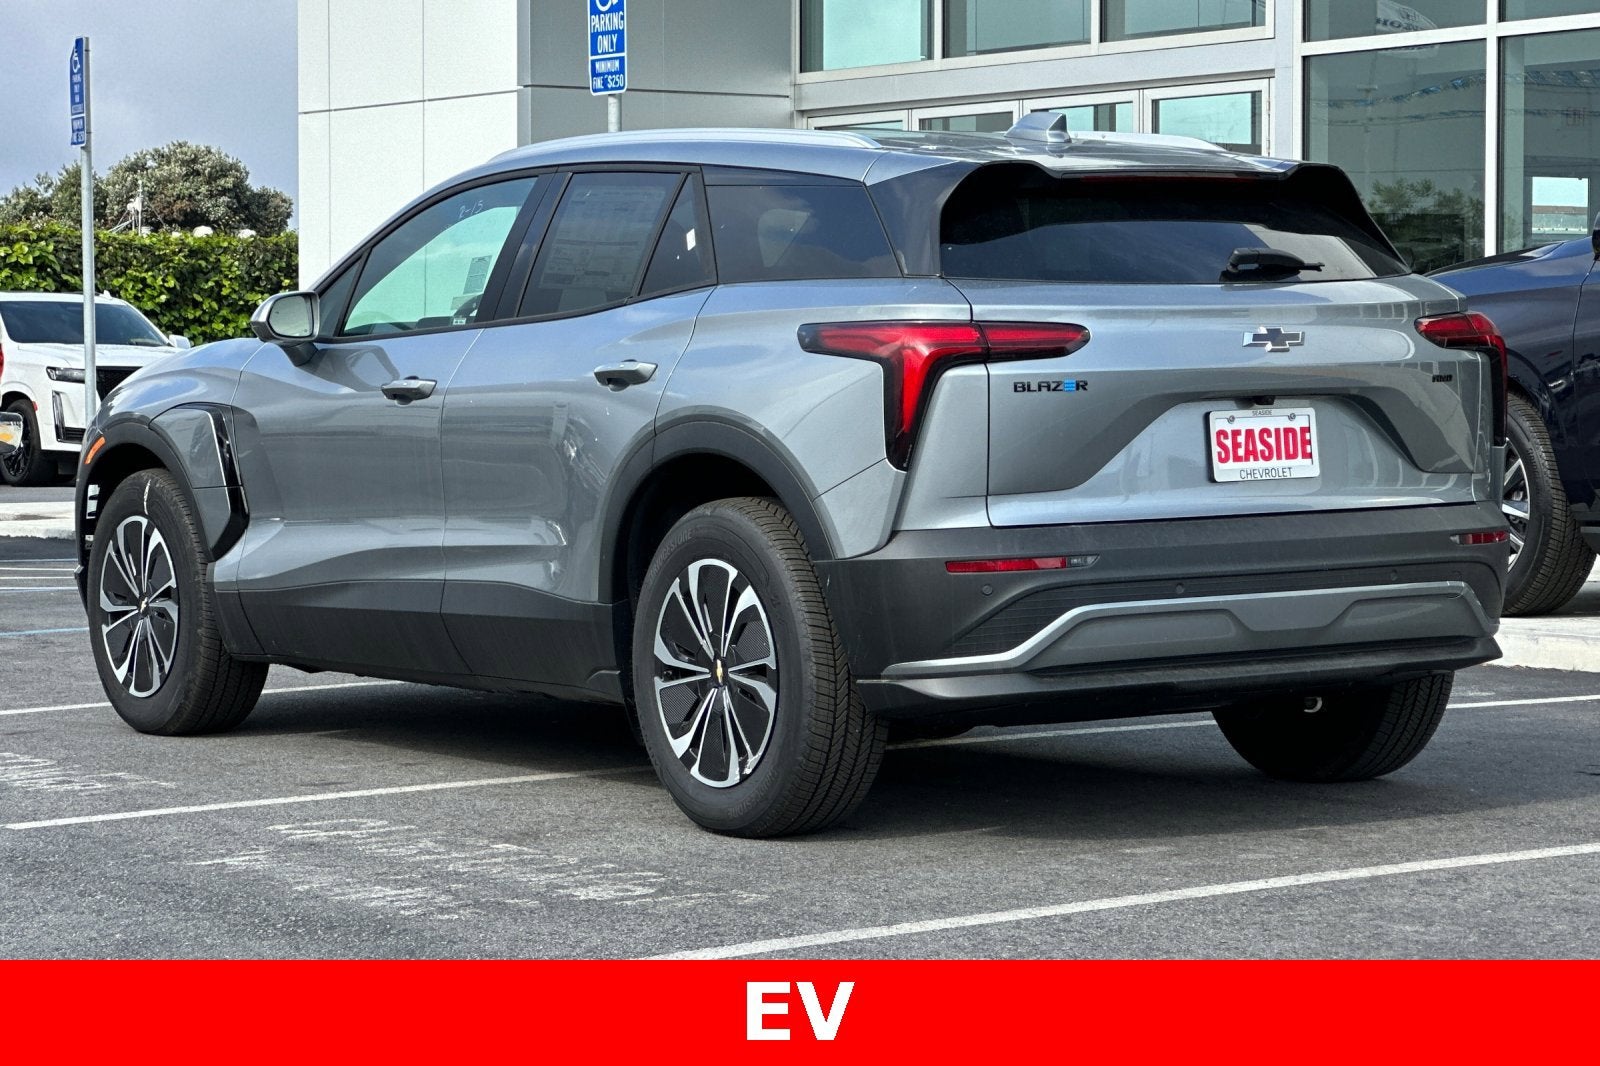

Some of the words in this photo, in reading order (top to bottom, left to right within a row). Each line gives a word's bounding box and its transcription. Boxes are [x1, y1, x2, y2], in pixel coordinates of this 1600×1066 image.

[591, 11, 624, 33] PARKING
[597, 33, 618, 54] ONLY
[595, 58, 620, 74] MINIMUM
[592, 76, 604, 90] FINE
[607, 73, 624, 89] $250
[1013, 378, 1089, 393] BLAZER
[1251, 409, 1273, 417] SEASIDE
[1215, 426, 1312, 465] SEASIDE
[1239, 467, 1293, 480] CHEVROLET
